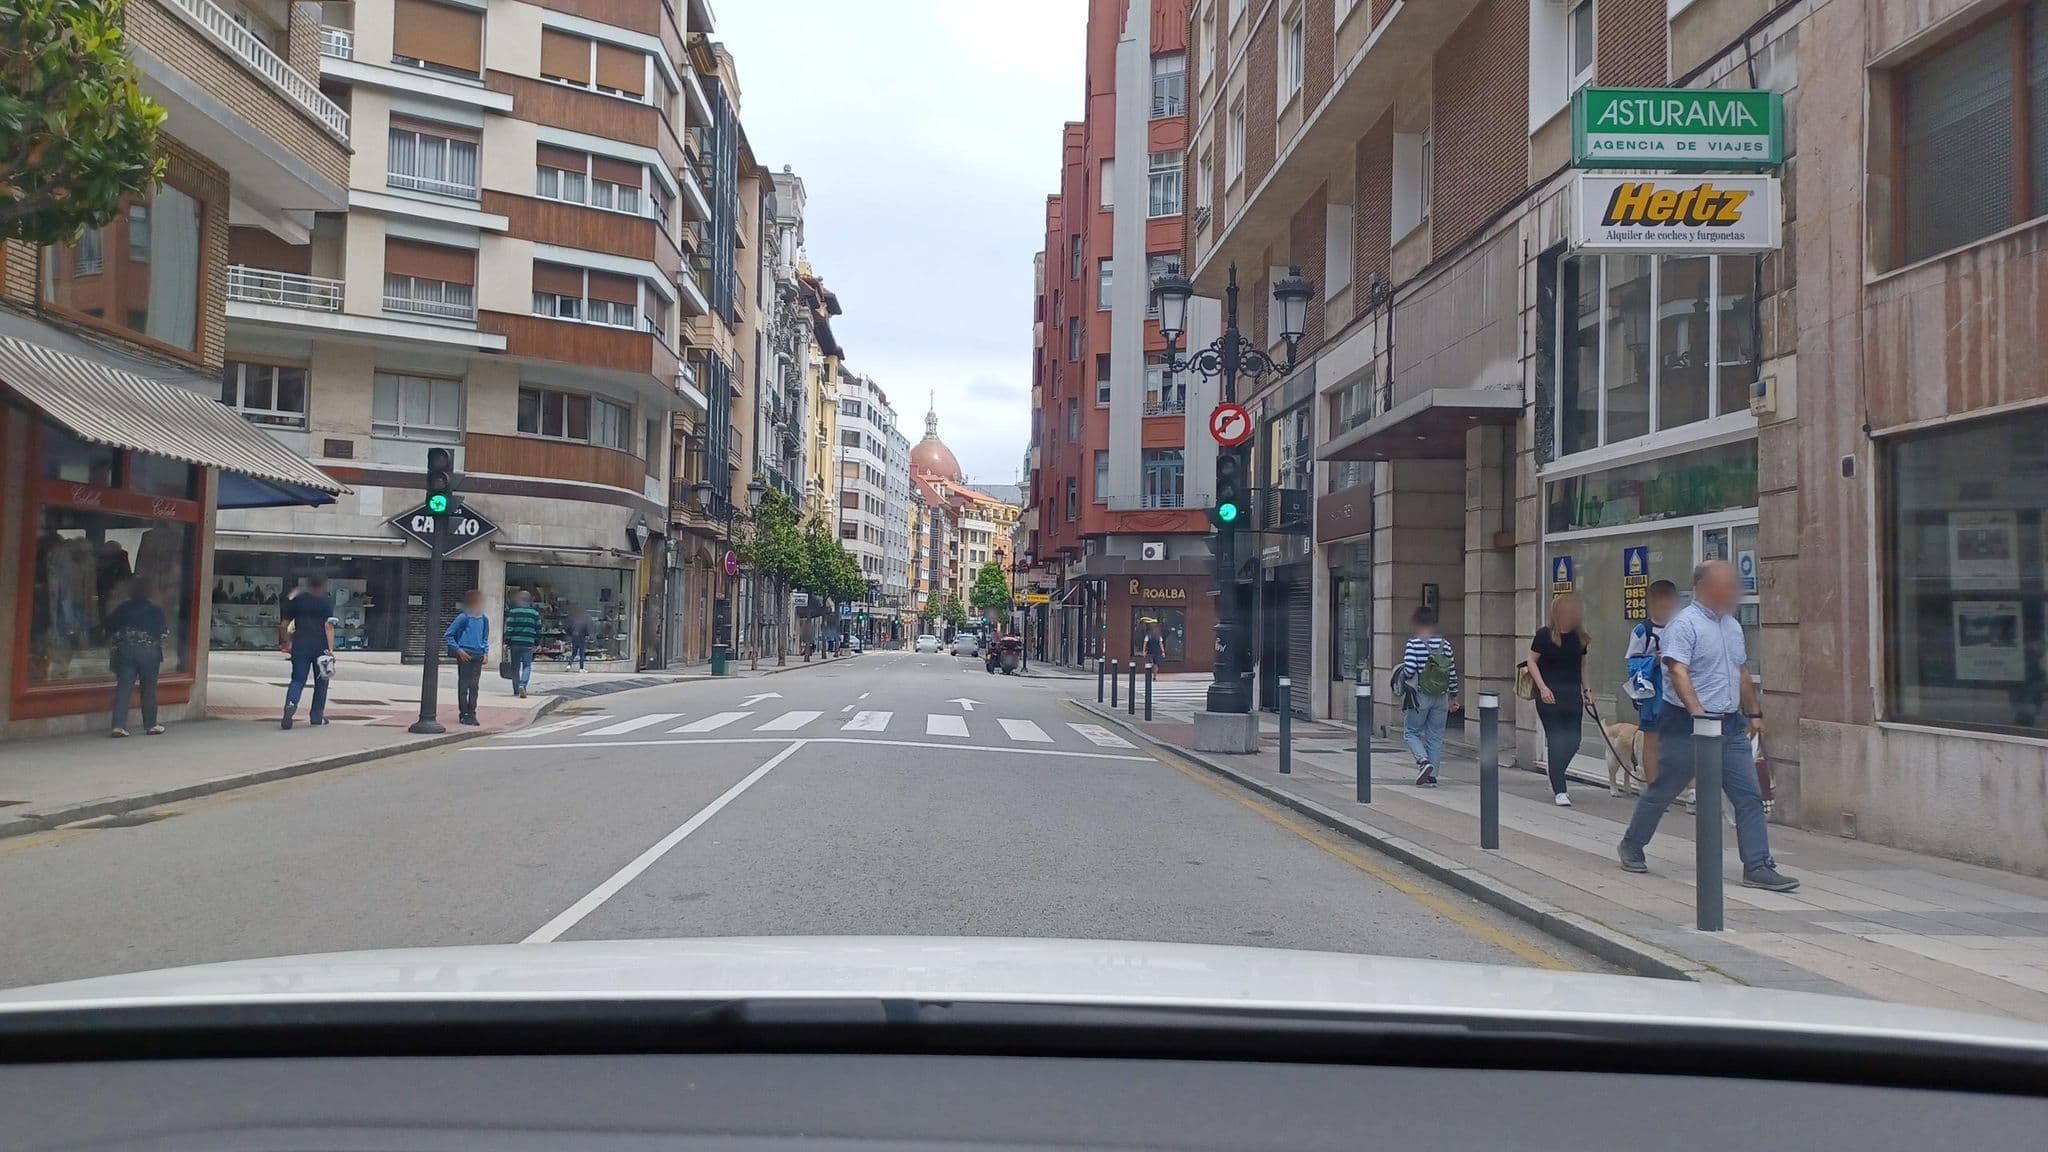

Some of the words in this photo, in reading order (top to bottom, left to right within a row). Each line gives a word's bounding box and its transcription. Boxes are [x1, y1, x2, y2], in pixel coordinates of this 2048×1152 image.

[1596, 99, 1758, 127] ASTURAMA
[1593, 141, 1665, 151] AGENCIA
[1676, 141, 1697, 151] DE
[1708, 142, 1763, 151] VIAJES
[1601, 182, 1749, 227] Hertz
[1606, 230, 1642, 242] Alquiler
[1645, 230, 1655, 240] de
[1657, 230, 1688, 240] coches
[1689, 232, 1695, 242] y
[1697, 230, 1745, 242] furgonetas
[1143, 588, 1186, 599] ROALBA
[1625, 588, 1646, 598] 985
[1625, 599, 1646, 608] 204
[1627, 609, 1646, 618] 103
